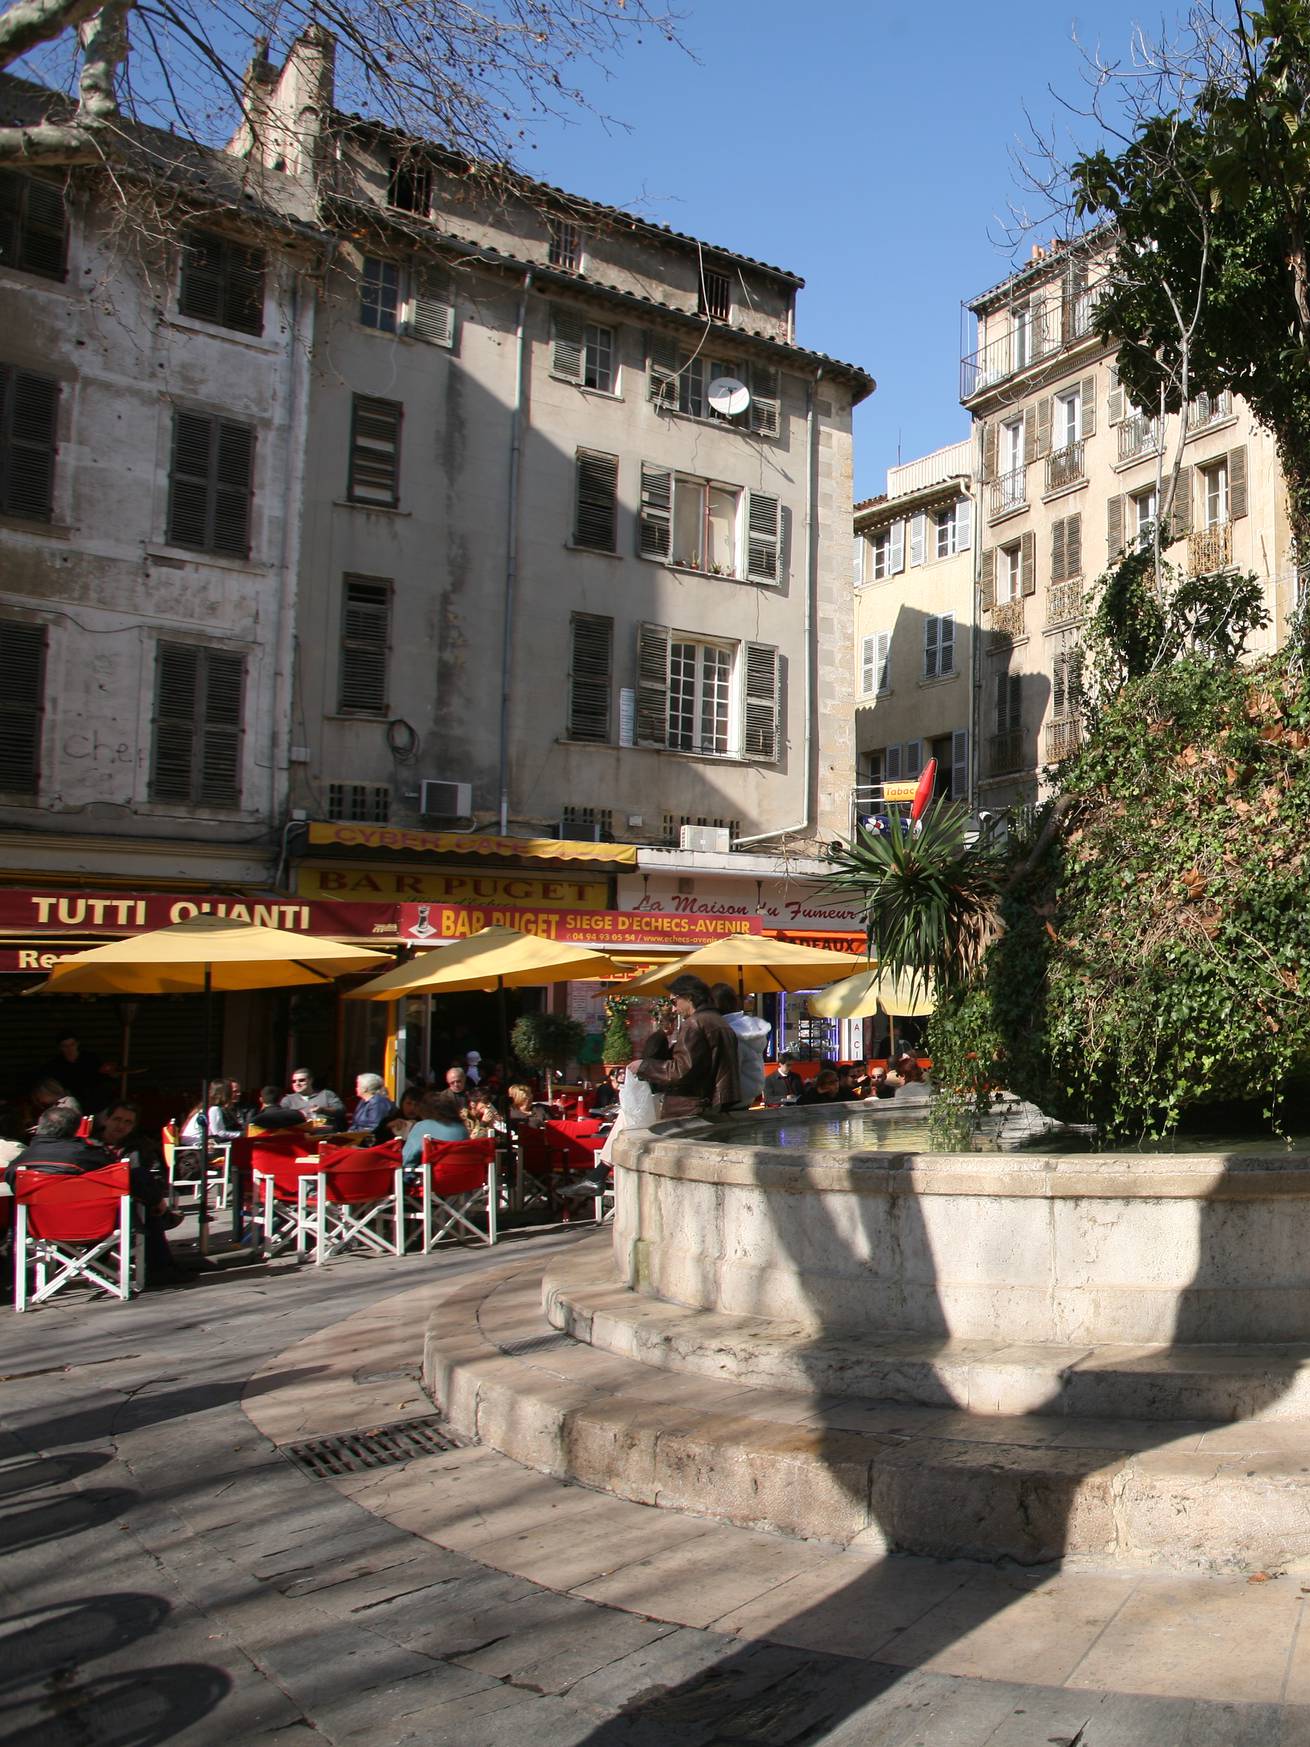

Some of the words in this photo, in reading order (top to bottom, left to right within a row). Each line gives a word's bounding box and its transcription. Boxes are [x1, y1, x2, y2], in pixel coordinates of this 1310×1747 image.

[886, 787, 914, 796] Tabac
[335, 827, 440, 849] CYBER
[318, 869, 425, 895] BAR
[442, 875, 595, 902] PUGET
[31, 896, 147, 925] TUTTI
[632, 895, 664, 912] La
[672, 895, 750, 915] Maison
[784, 902, 857, 920] Fumeur
[441, 909, 486, 937] BAR
[566, 914, 613, 930] SIEGE
[618, 916, 750, 935] D'ECHECS-AVENIR
[572, 932, 584, 941] 04
[586, 933, 597, 941] 94
